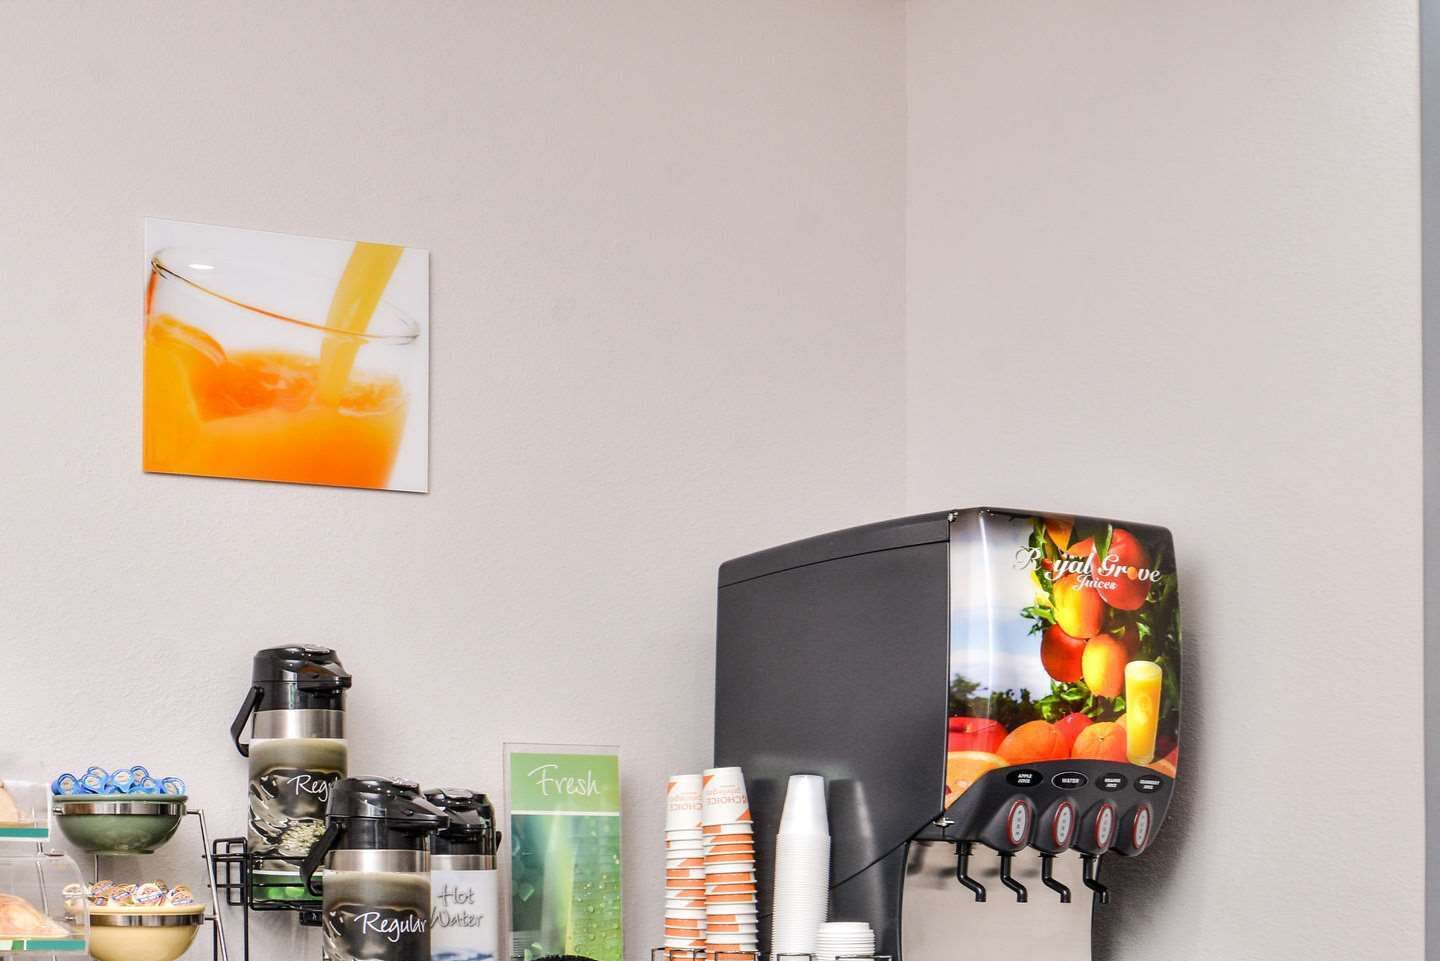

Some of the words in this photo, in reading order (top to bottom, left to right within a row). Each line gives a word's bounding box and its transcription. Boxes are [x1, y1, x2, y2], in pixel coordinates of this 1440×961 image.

[1072, 572, 1117, 590] Juices
[527, 763, 601, 797] Fresh
[437, 883, 476, 907] Hot
[354, 911, 427, 943] Regular
[431, 906, 484, 930] Water
